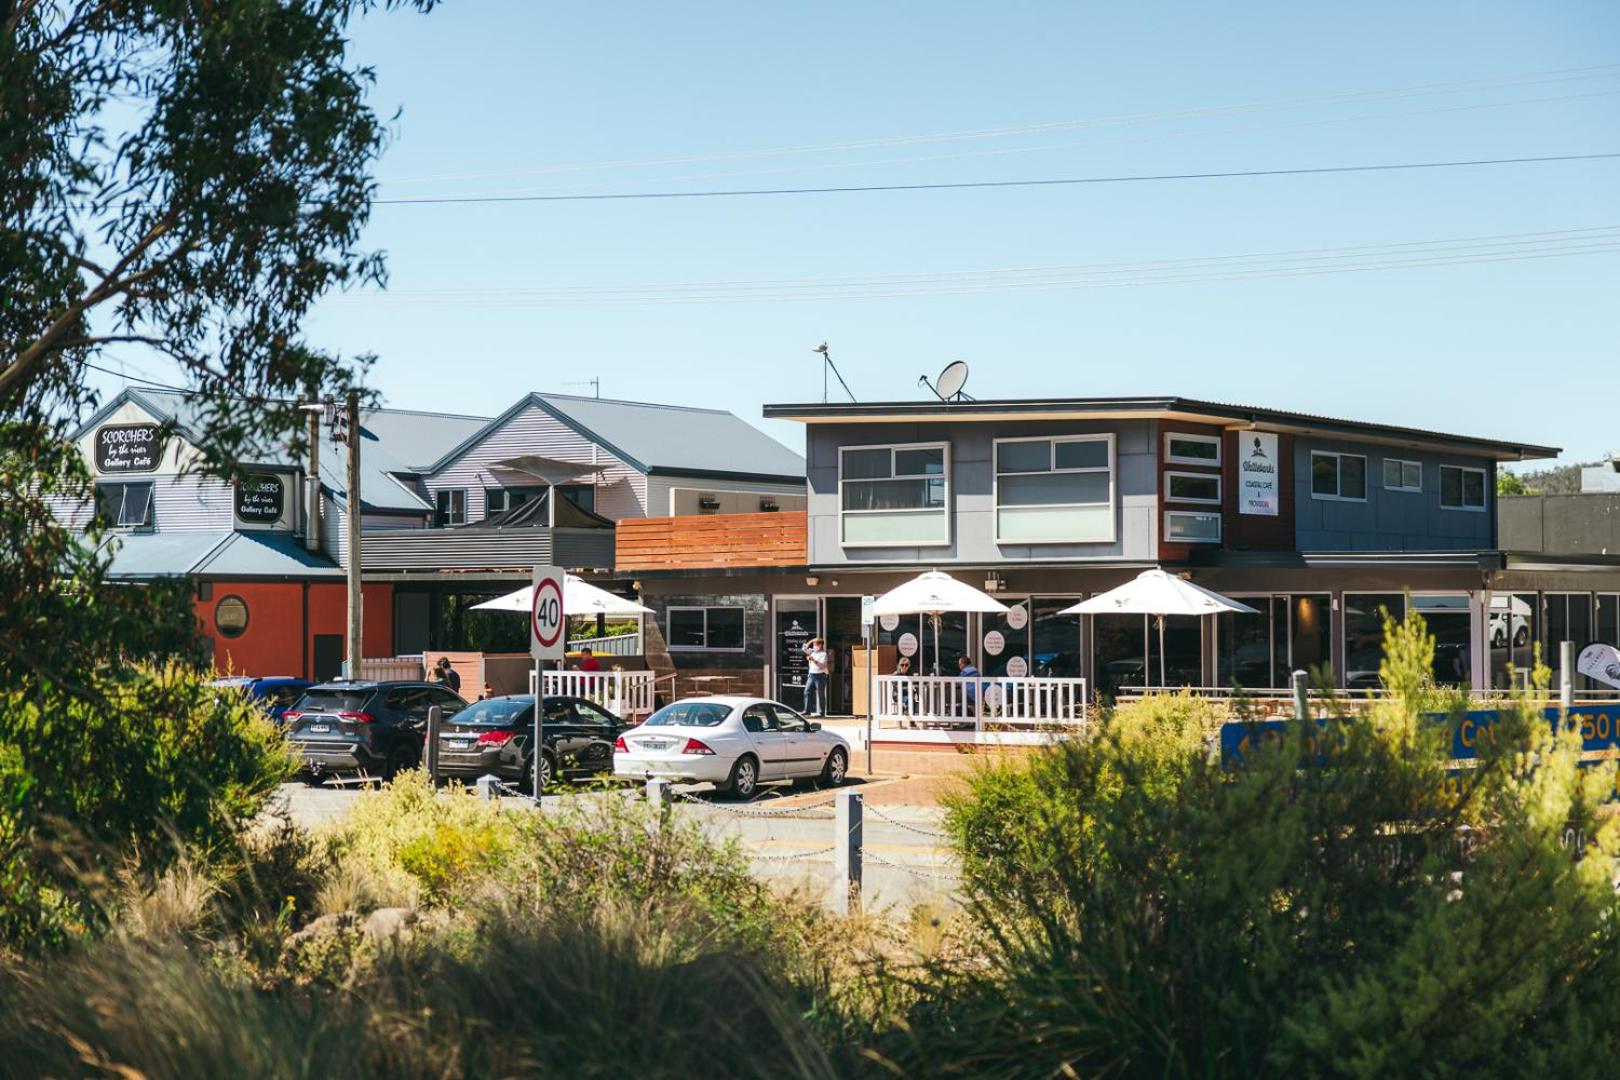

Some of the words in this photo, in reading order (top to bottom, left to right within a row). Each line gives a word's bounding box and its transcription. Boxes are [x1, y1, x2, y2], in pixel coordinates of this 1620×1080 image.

[102, 428, 154, 444] SCORCHERS
[119, 443, 129, 455] the
[104, 458, 131, 468] Gallery
[241, 505, 262, 515] Gallery
[538, 598, 559, 627] 40
